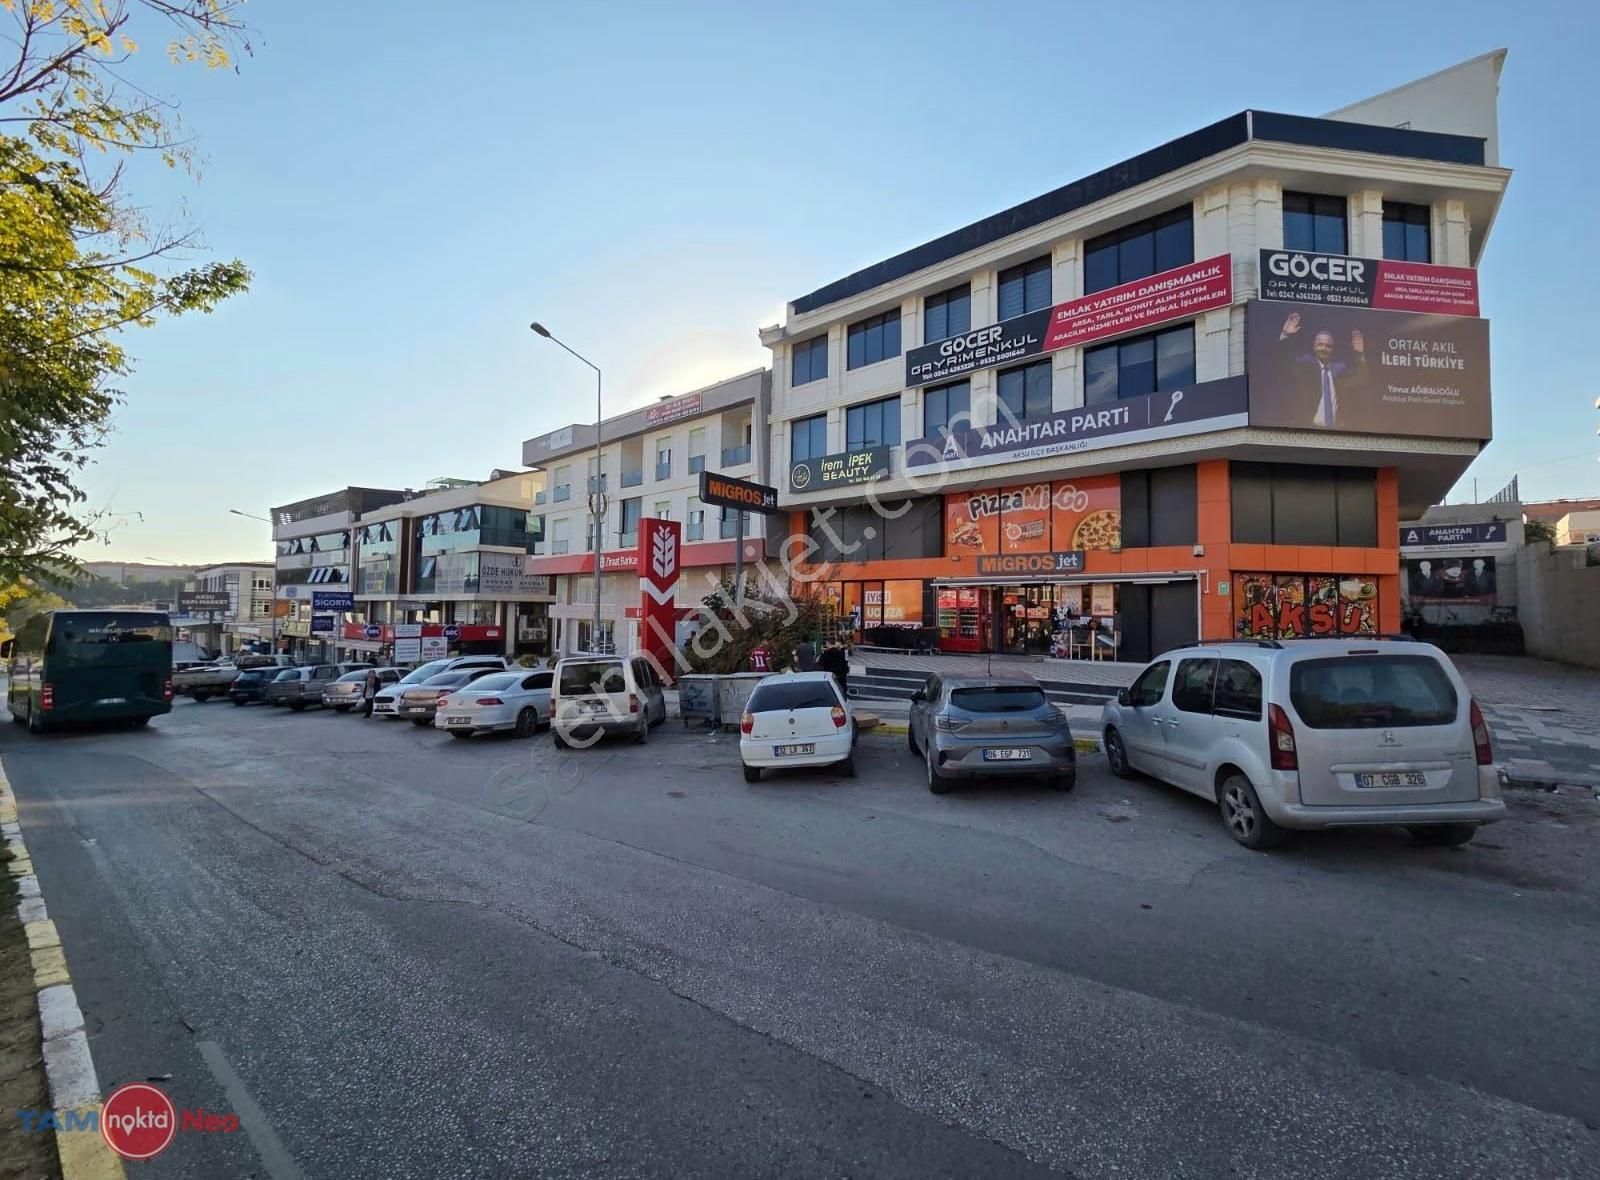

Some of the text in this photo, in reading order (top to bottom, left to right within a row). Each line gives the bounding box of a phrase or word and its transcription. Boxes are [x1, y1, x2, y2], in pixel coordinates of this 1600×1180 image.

[1269, 252, 1364, 283] GÖÇER
[1057, 265, 1221, 320] EMLAK YATIRIM DANIŞMANLIK
[1125, 302, 1152, 314] KONUT
[1053, 328, 1087, 342] ARACILIK
[1134, 311, 1145, 320] VE
[1389, 339, 1456, 354] ORTAK AKIL
[1382, 352, 1464, 370] İLERİ TÜRKİYE
[980, 419, 1066, 449] ANAHTAR
[823, 466, 869, 480] BEAUTY
[762, 492, 774, 506] jet
[1429, 528, 1472, 536] ANAHTAR
[606, 556, 638, 566] Ziraat Bankas
[1056, 554, 1078, 570] jet
[1250, 602, 1360, 634] AKSU
[755, 656, 765, 667] 11
[1362, 775, 1374, 786] 07
[1406, 774, 1425, 785] 326
